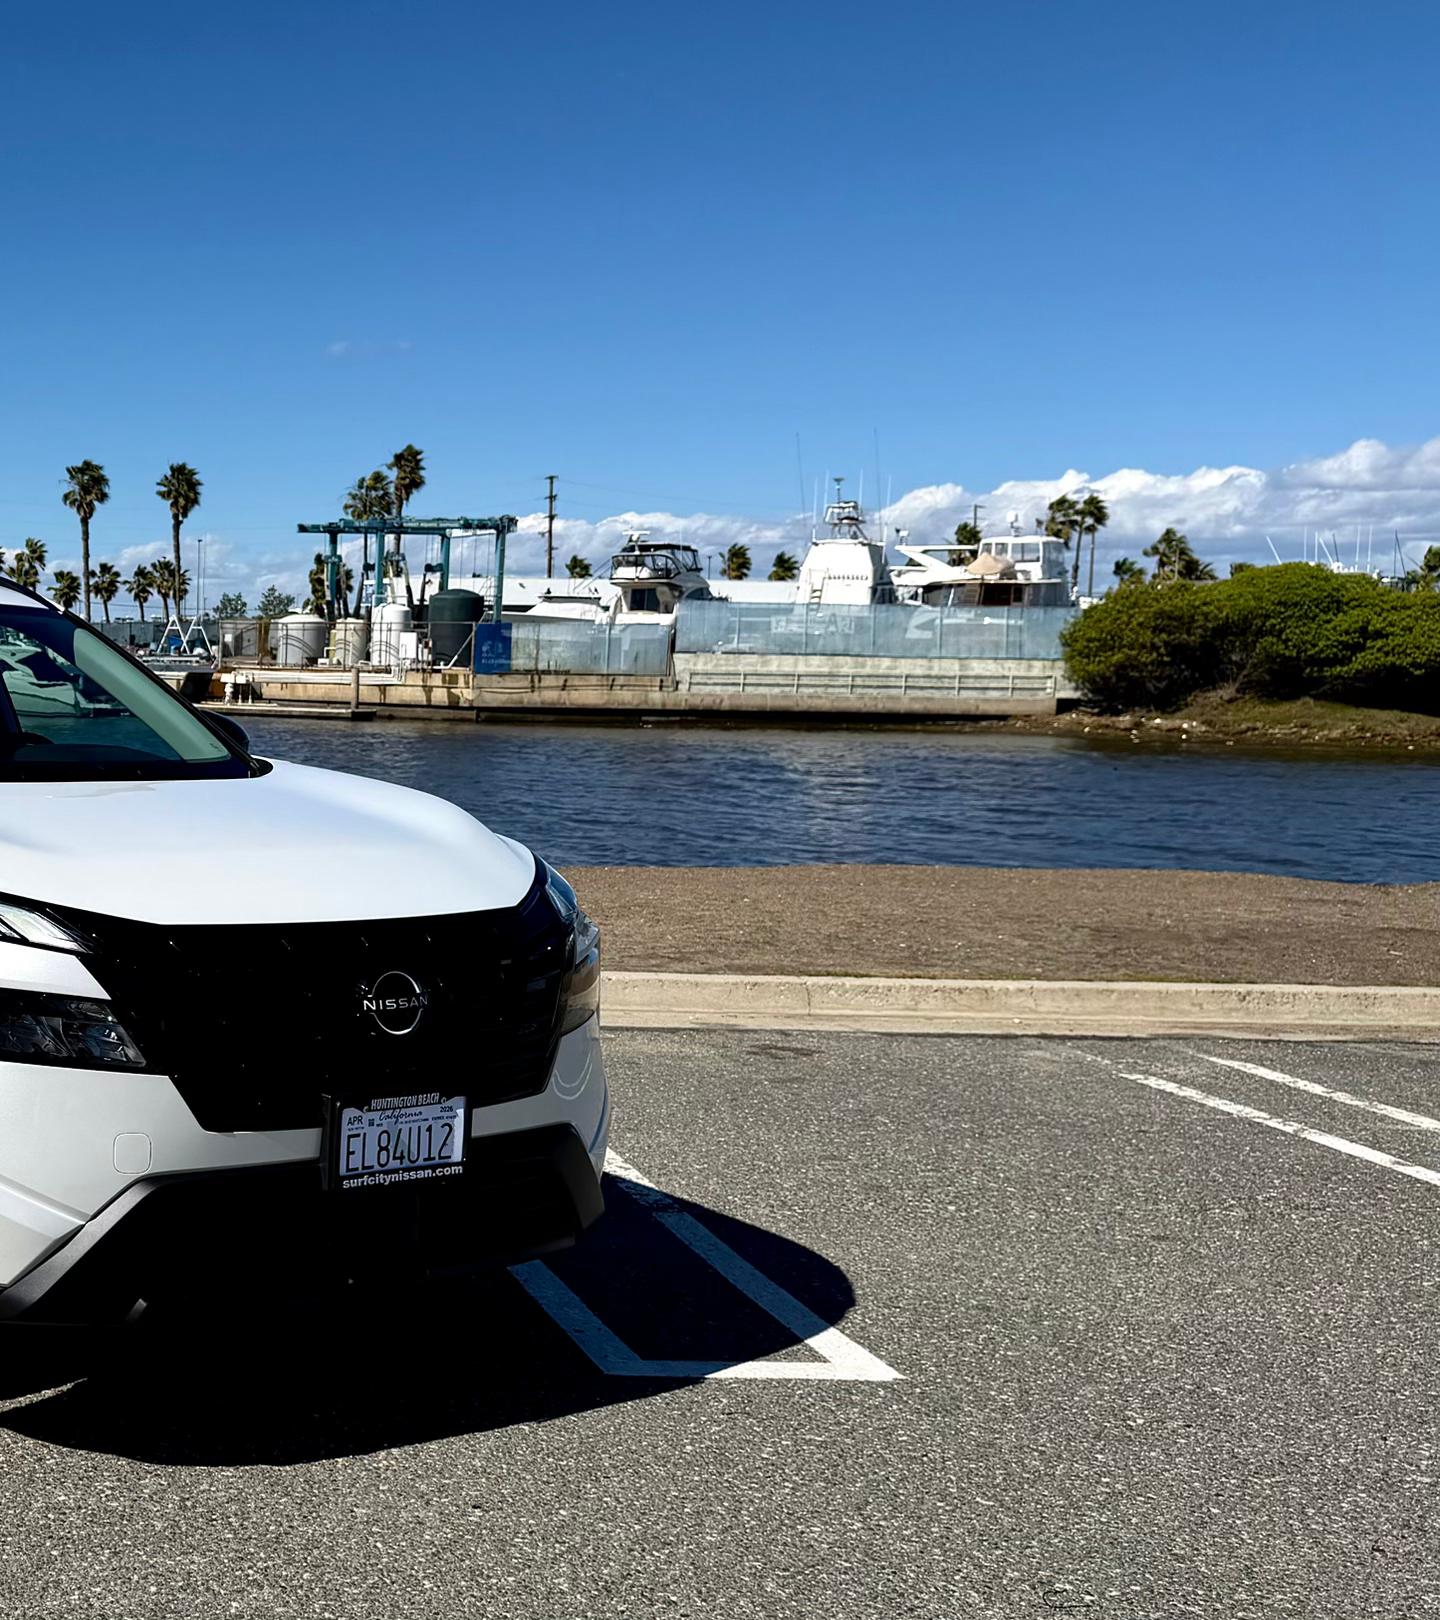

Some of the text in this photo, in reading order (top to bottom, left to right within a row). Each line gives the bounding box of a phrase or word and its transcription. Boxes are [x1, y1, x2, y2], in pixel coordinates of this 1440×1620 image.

[363, 995, 428, 1011] NISSAN
[371, 1092, 440, 1110] HUNTINGTON BEACH
[347, 1115, 363, 1126] APR
[379, 1108, 423, 1125] California
[345, 1122, 454, 1173] EL84U12
[342, 1165, 464, 1189] surfcitynissan.com
